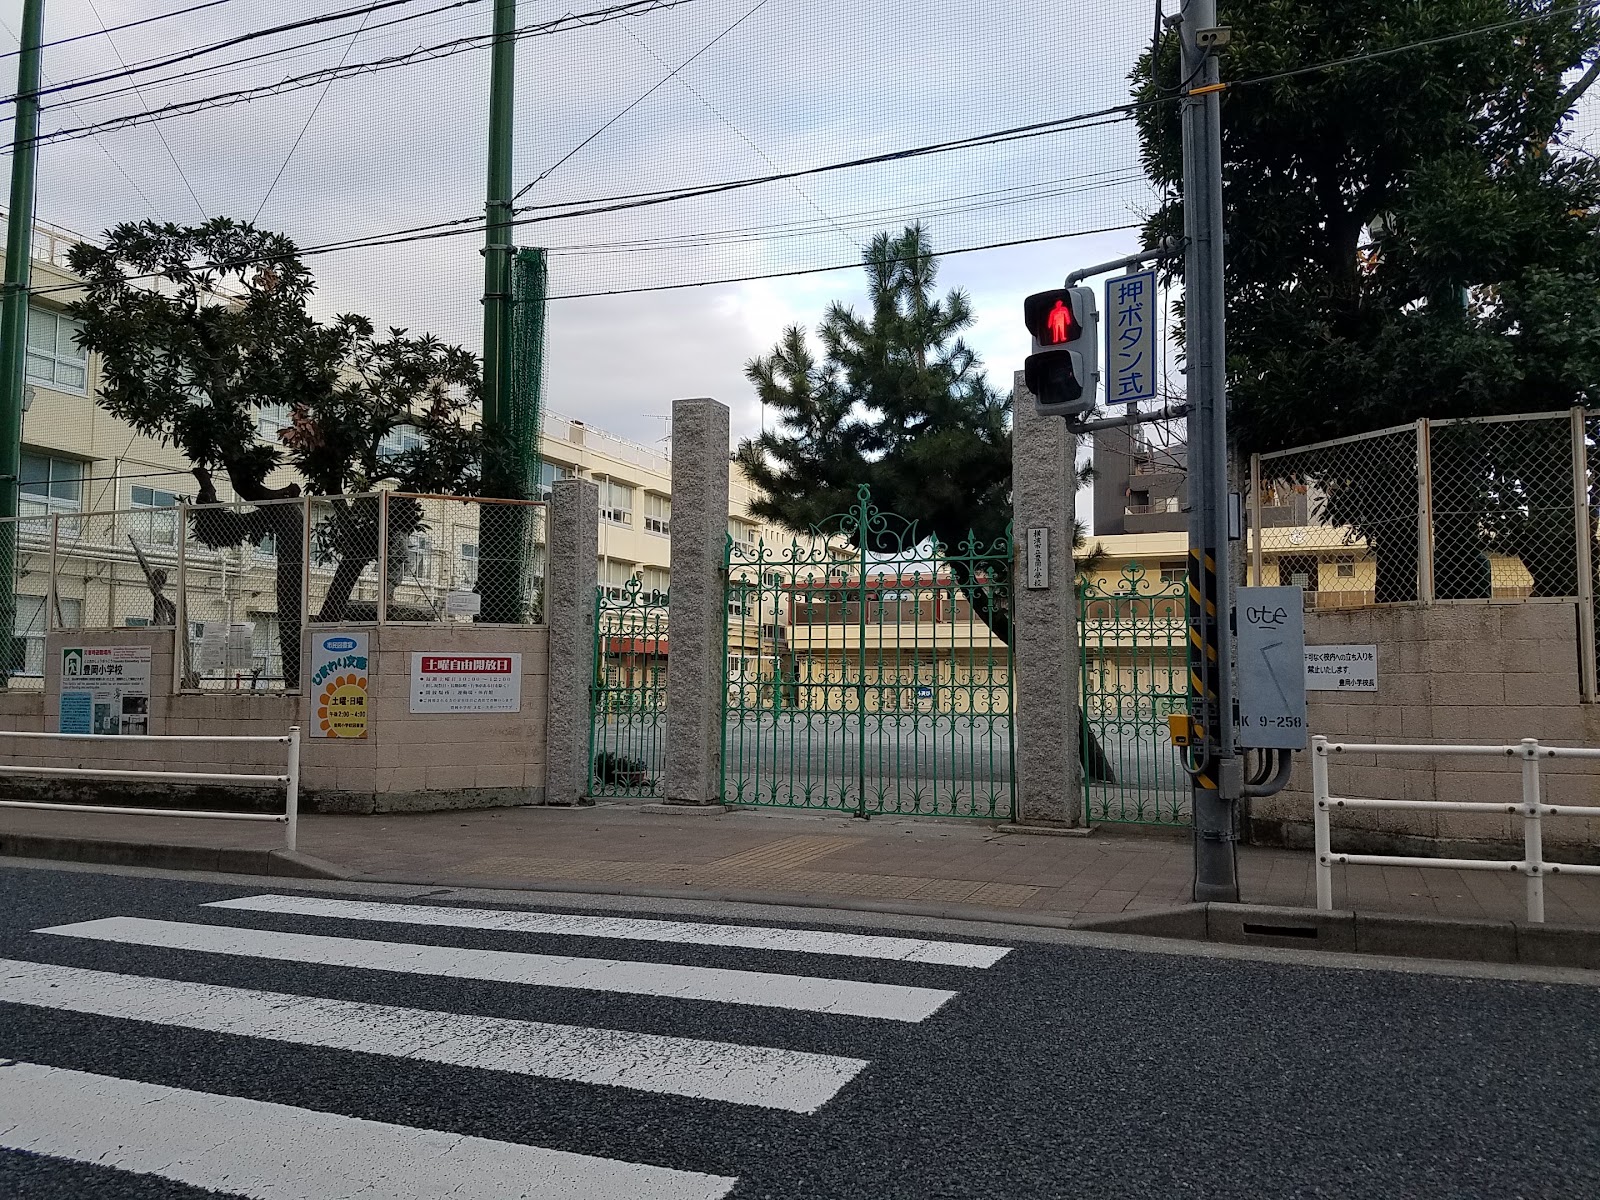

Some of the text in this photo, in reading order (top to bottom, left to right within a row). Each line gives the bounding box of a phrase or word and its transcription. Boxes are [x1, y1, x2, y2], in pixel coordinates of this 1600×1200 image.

[1118, 280, 1143, 396] 押ボタン式
[1305, 652, 1374, 662] 可なく校内への立ち入りを
[83, 665, 123, 675] 豊岡小学校
[425, 659, 508, 671] 土曜自由開放日
[1241, 715, 1302, 728] K 9-258
